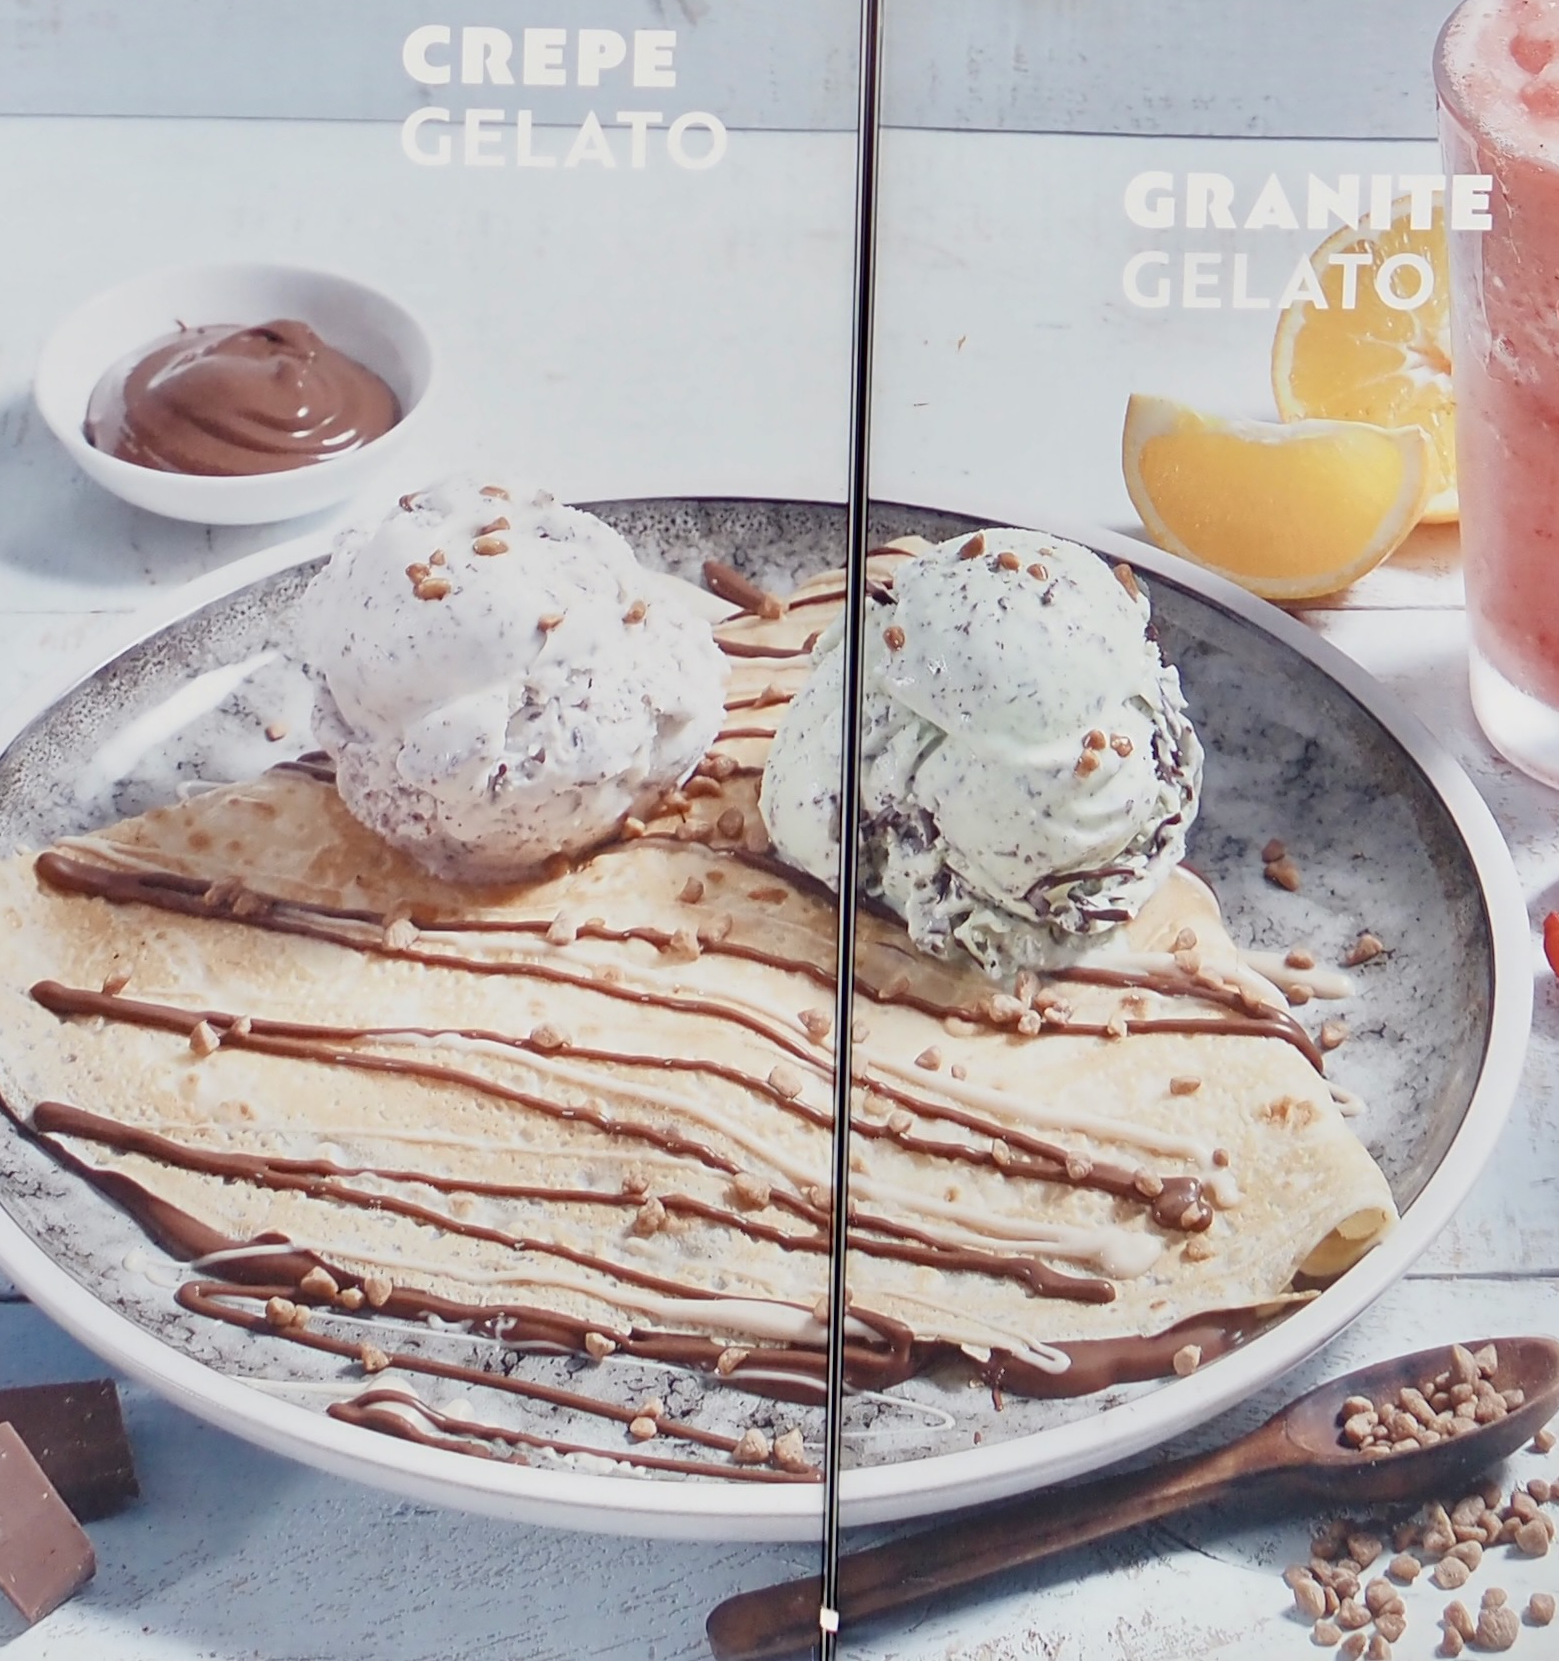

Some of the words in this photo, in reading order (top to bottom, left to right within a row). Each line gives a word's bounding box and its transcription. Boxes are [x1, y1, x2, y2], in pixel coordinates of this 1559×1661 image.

[402, 24, 678, 87] CREPE
[401, 106, 729, 171] GELATO
[1123, 170, 1493, 231] GRANITE
[1122, 251, 1435, 311] GELATO
